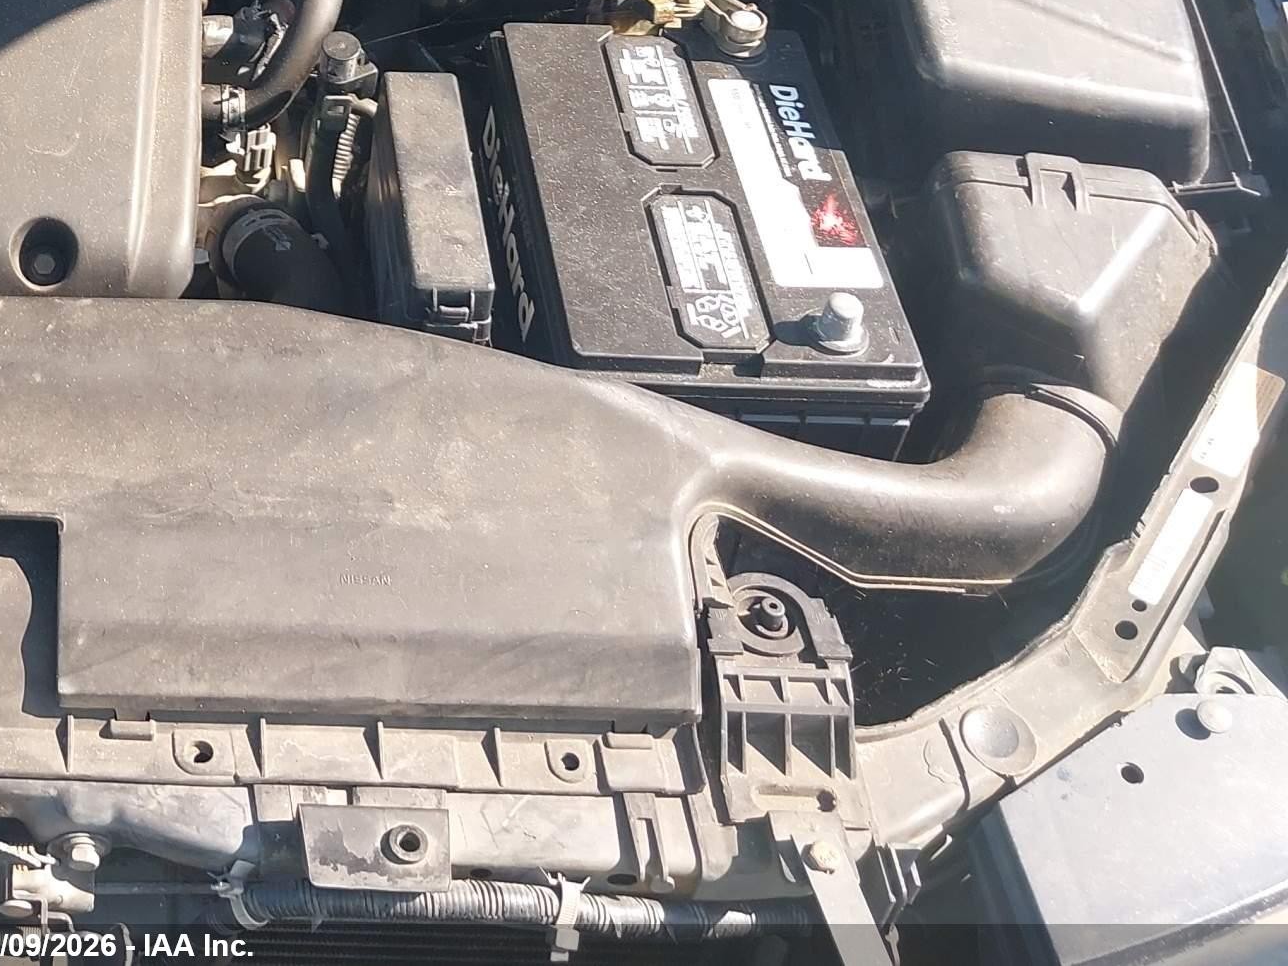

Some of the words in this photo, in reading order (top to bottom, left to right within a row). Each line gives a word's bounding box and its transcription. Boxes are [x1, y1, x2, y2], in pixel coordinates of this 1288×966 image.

[768, 84, 833, 181] DieHard
[483, 105, 535, 342] DieHard
[339, 574, 392, 586] NISSAN
